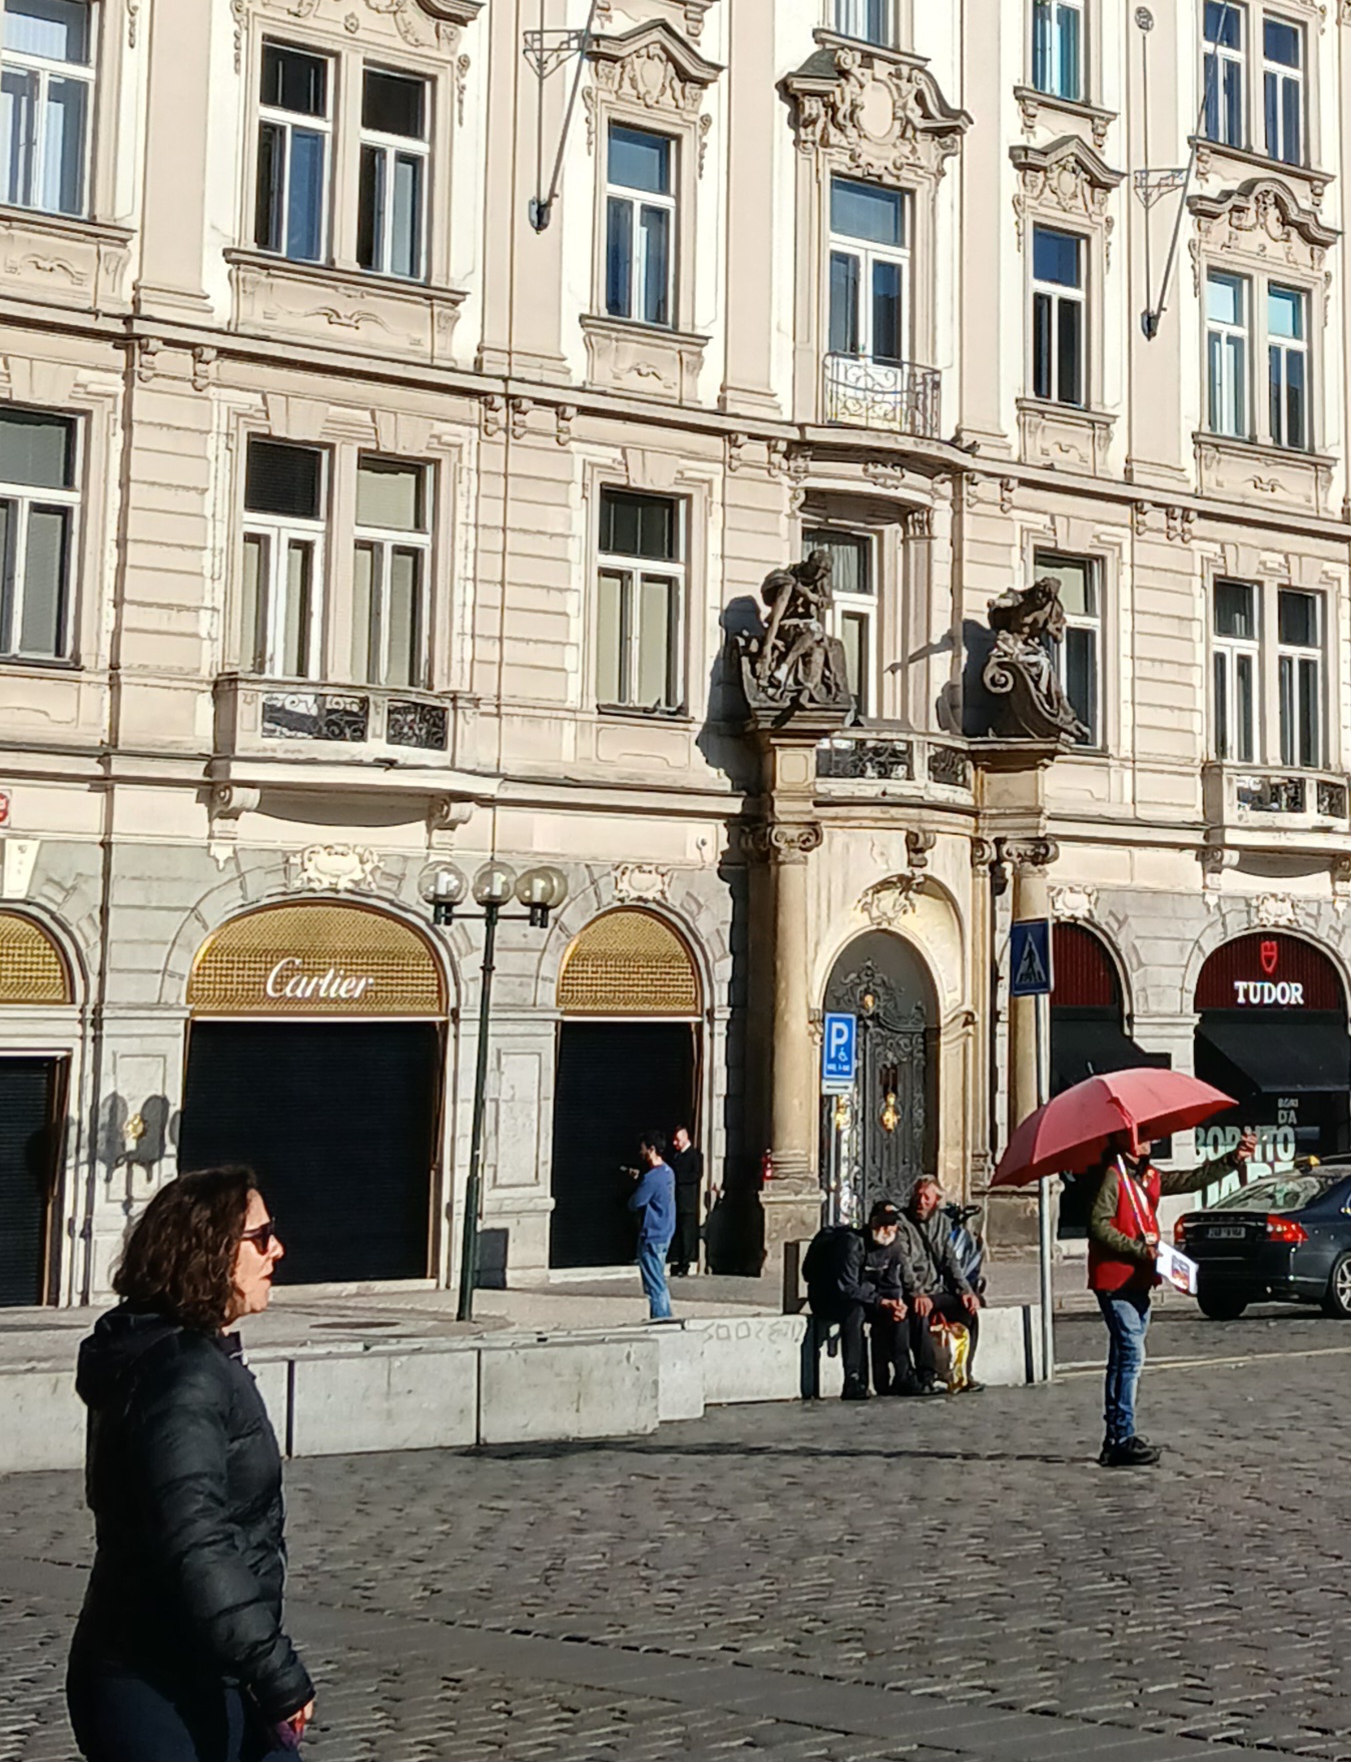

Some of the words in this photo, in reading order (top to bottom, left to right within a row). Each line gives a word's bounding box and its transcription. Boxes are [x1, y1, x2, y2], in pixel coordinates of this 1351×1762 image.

[266, 956, 374, 998] Cartier
[1234, 981, 1304, 1005] TUDOR
[831, 1021, 849, 1059] P
